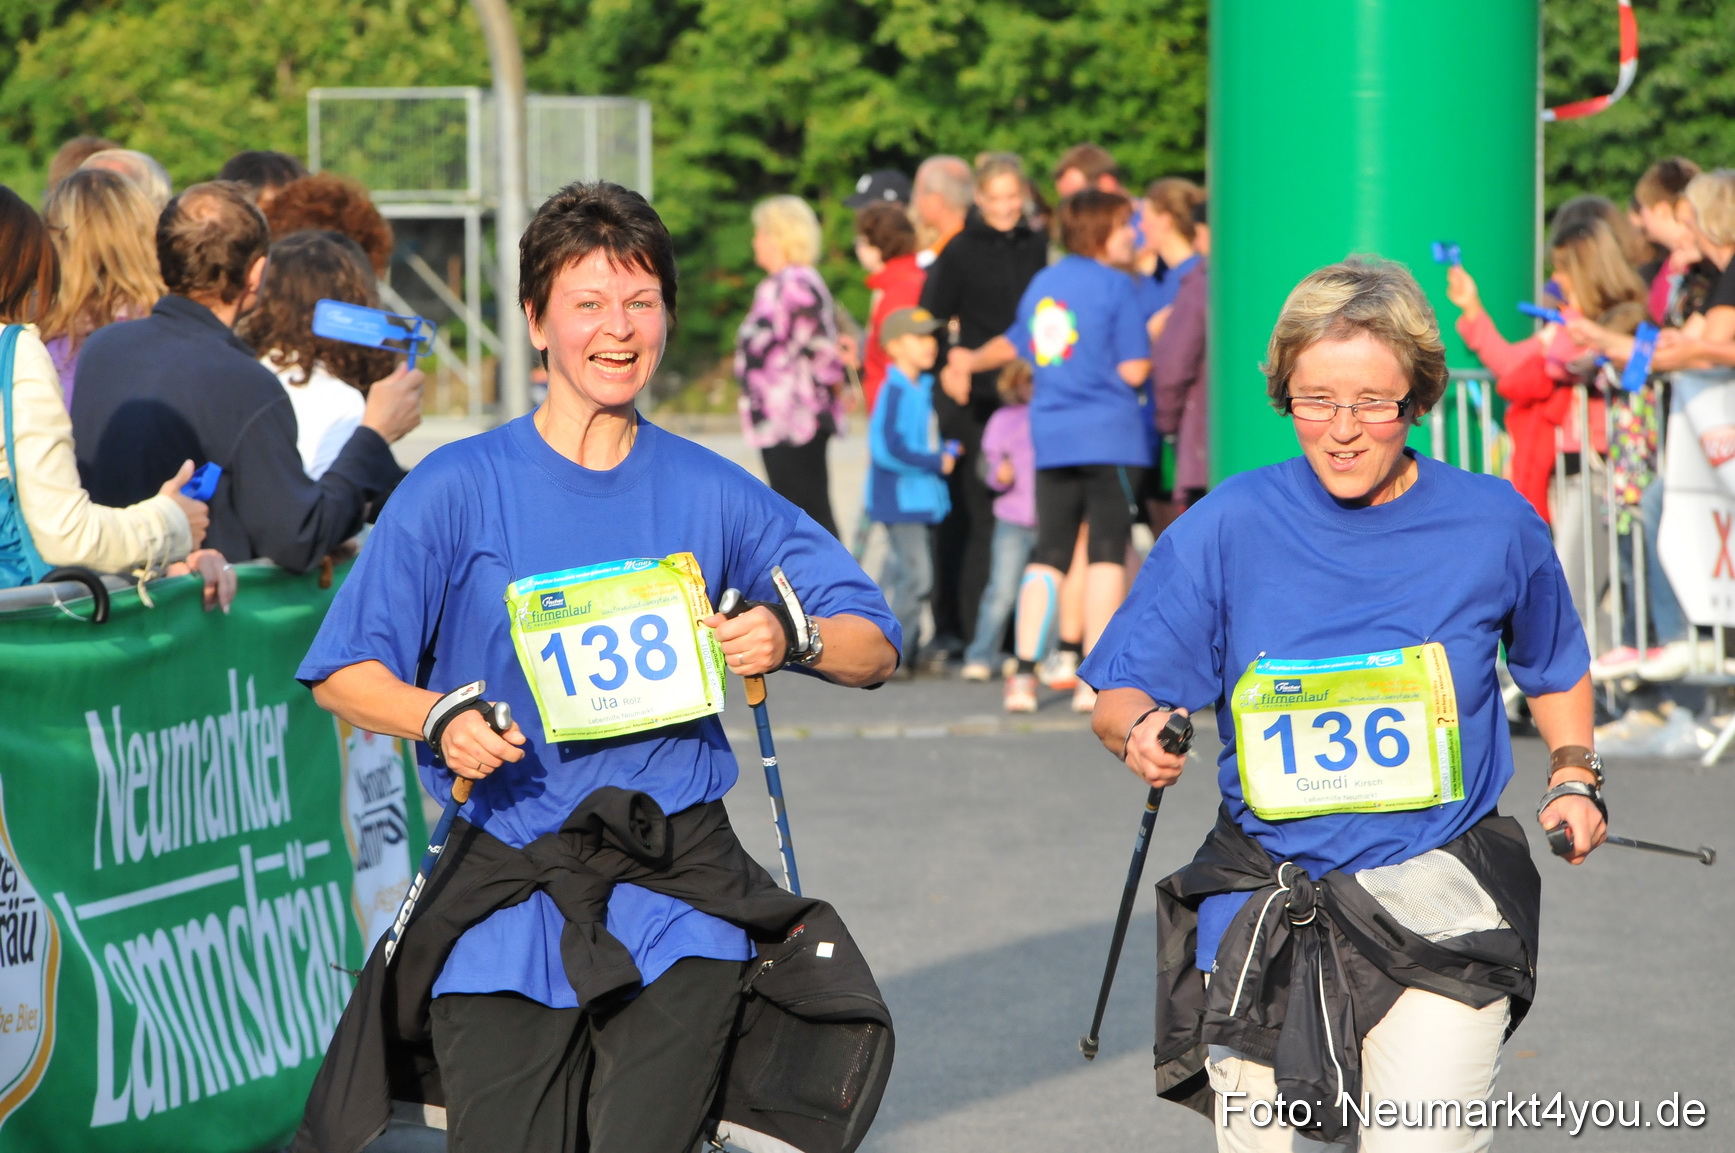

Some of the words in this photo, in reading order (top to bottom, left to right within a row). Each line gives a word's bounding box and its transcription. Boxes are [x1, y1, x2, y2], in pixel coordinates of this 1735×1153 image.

[532, 601, 592, 623] firmenlauf
[541, 614, 678, 697] 138
[590, 697, 618, 711] Uta
[1261, 690, 1330, 705] firmenlauf
[621, 708, 654, 719] Neumarkt
[1437, 717, 1455, 725] ?
[1263, 706, 1411, 775] 136
[85, 668, 291, 870] Neumarkter
[1296, 775, 1348, 792] Gundi
[1354, 778, 1383, 788] Kirsch
[53, 839, 351, 1128] Lammsbräu
[15, 1002, 38, 1034] Bier
